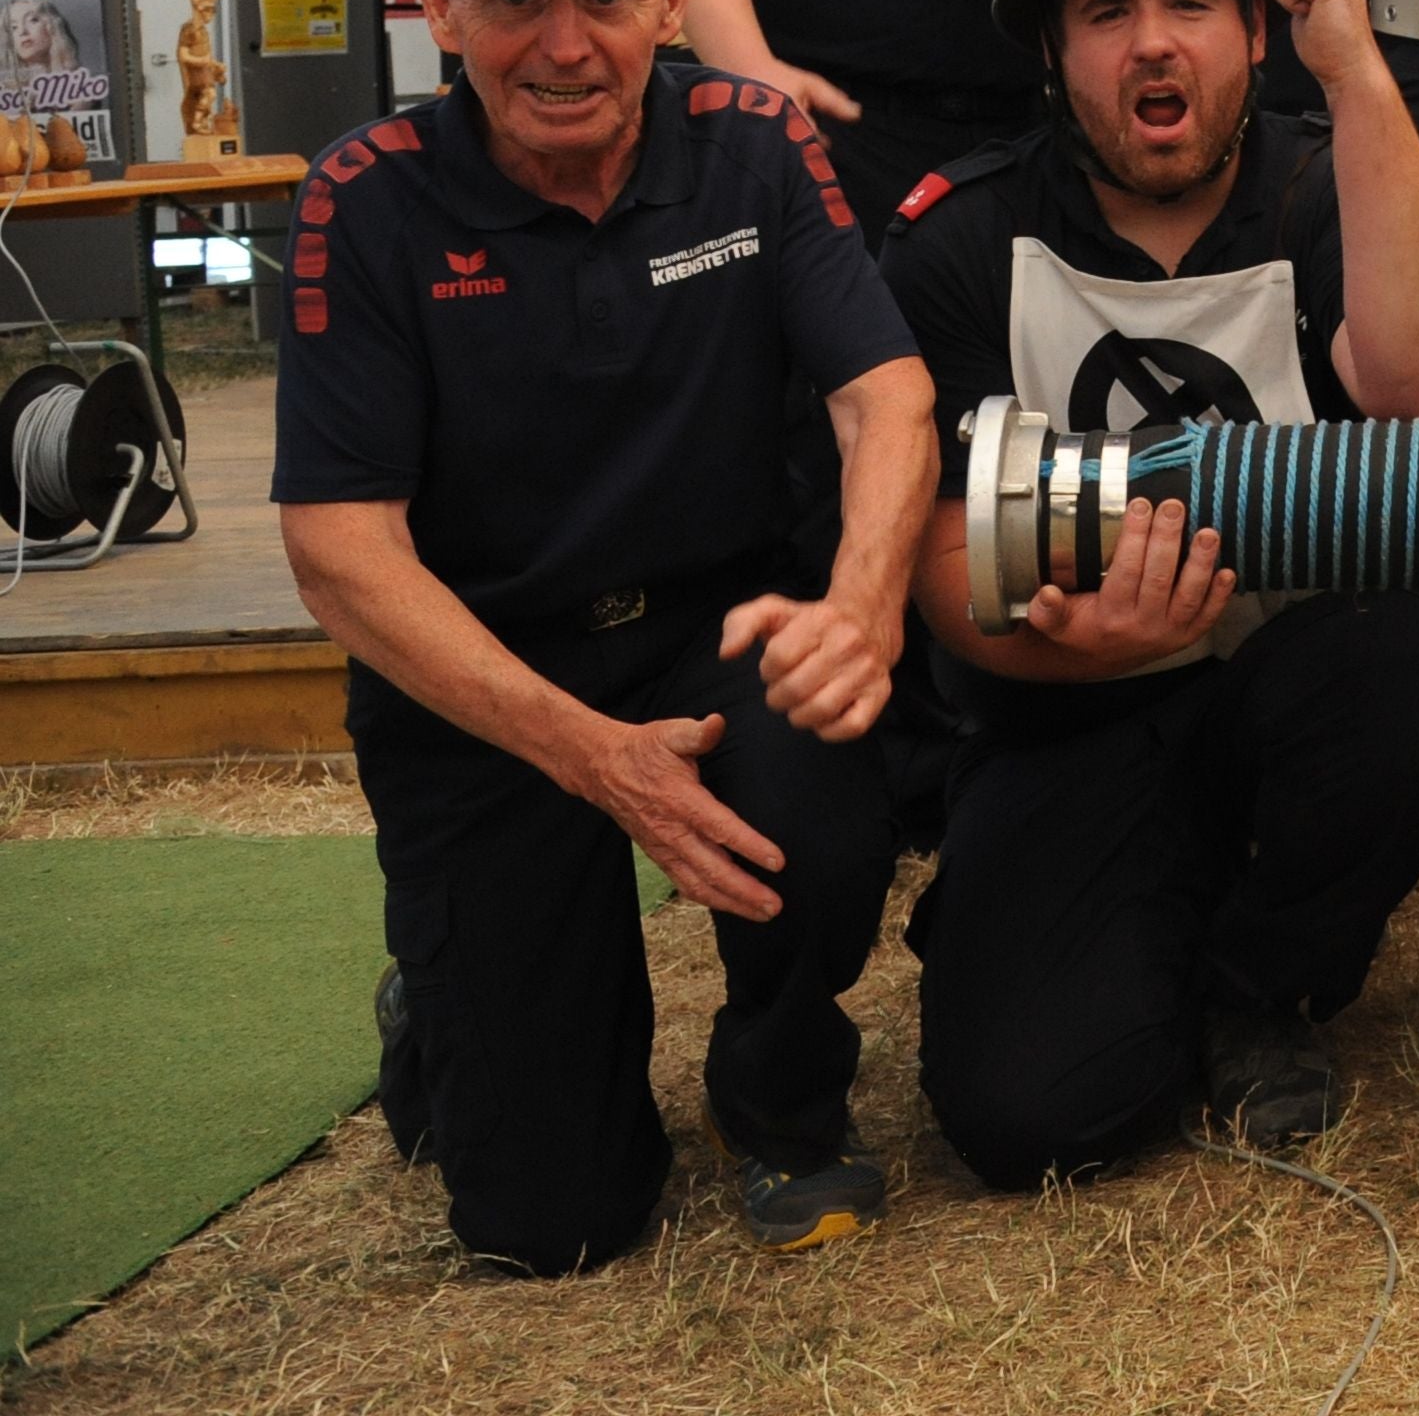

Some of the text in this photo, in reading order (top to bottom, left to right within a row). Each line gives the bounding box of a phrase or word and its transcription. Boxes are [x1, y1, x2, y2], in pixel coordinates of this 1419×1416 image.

[33, 70, 108, 105] Miko
[703, 227, 759, 252] FEUERWEHR
[651, 238, 760, 287] KRENSTETTEN
[432, 277, 506, 298] erima
